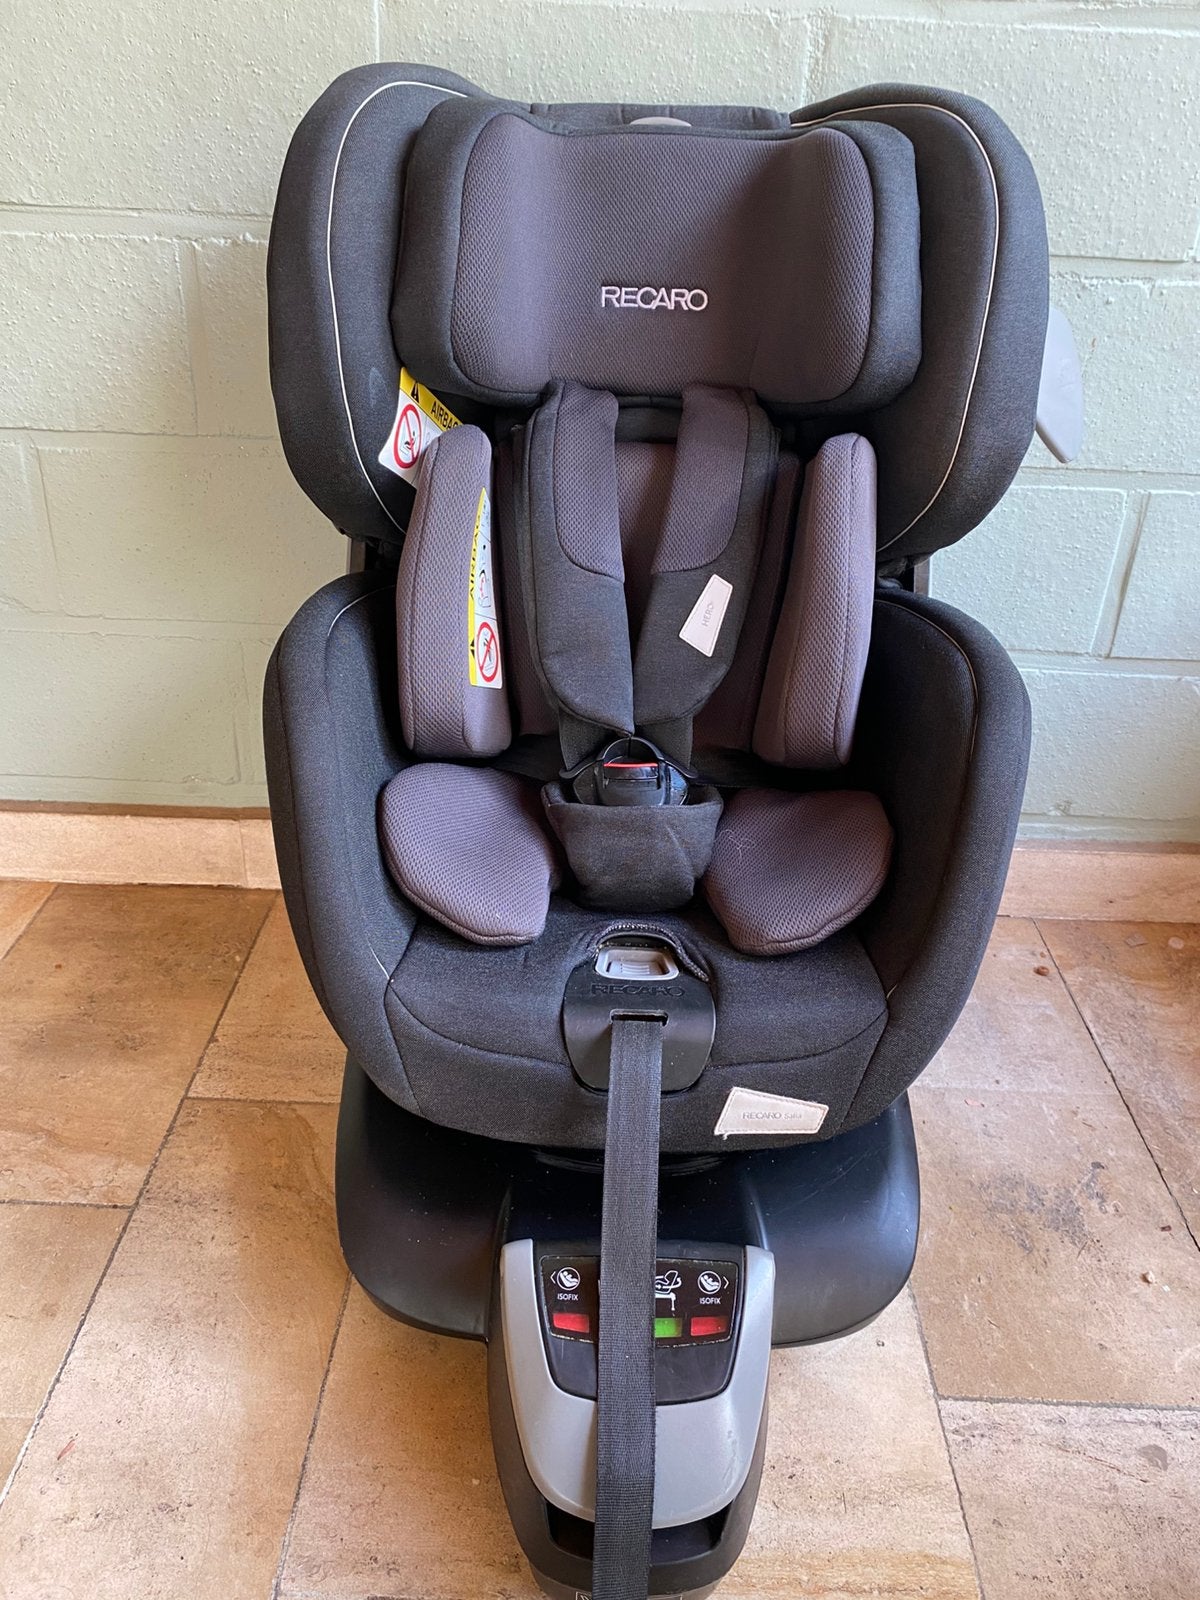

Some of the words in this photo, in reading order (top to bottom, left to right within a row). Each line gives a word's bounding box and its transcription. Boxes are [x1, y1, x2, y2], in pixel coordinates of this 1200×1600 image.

[601, 286, 708, 311] RECARO
[591, 983, 685, 997] RECARO
[742, 1111, 782, 1120] RECARO
[557, 1293, 579, 1301] ISOFIX
[699, 1297, 722, 1305] ISOFIX
